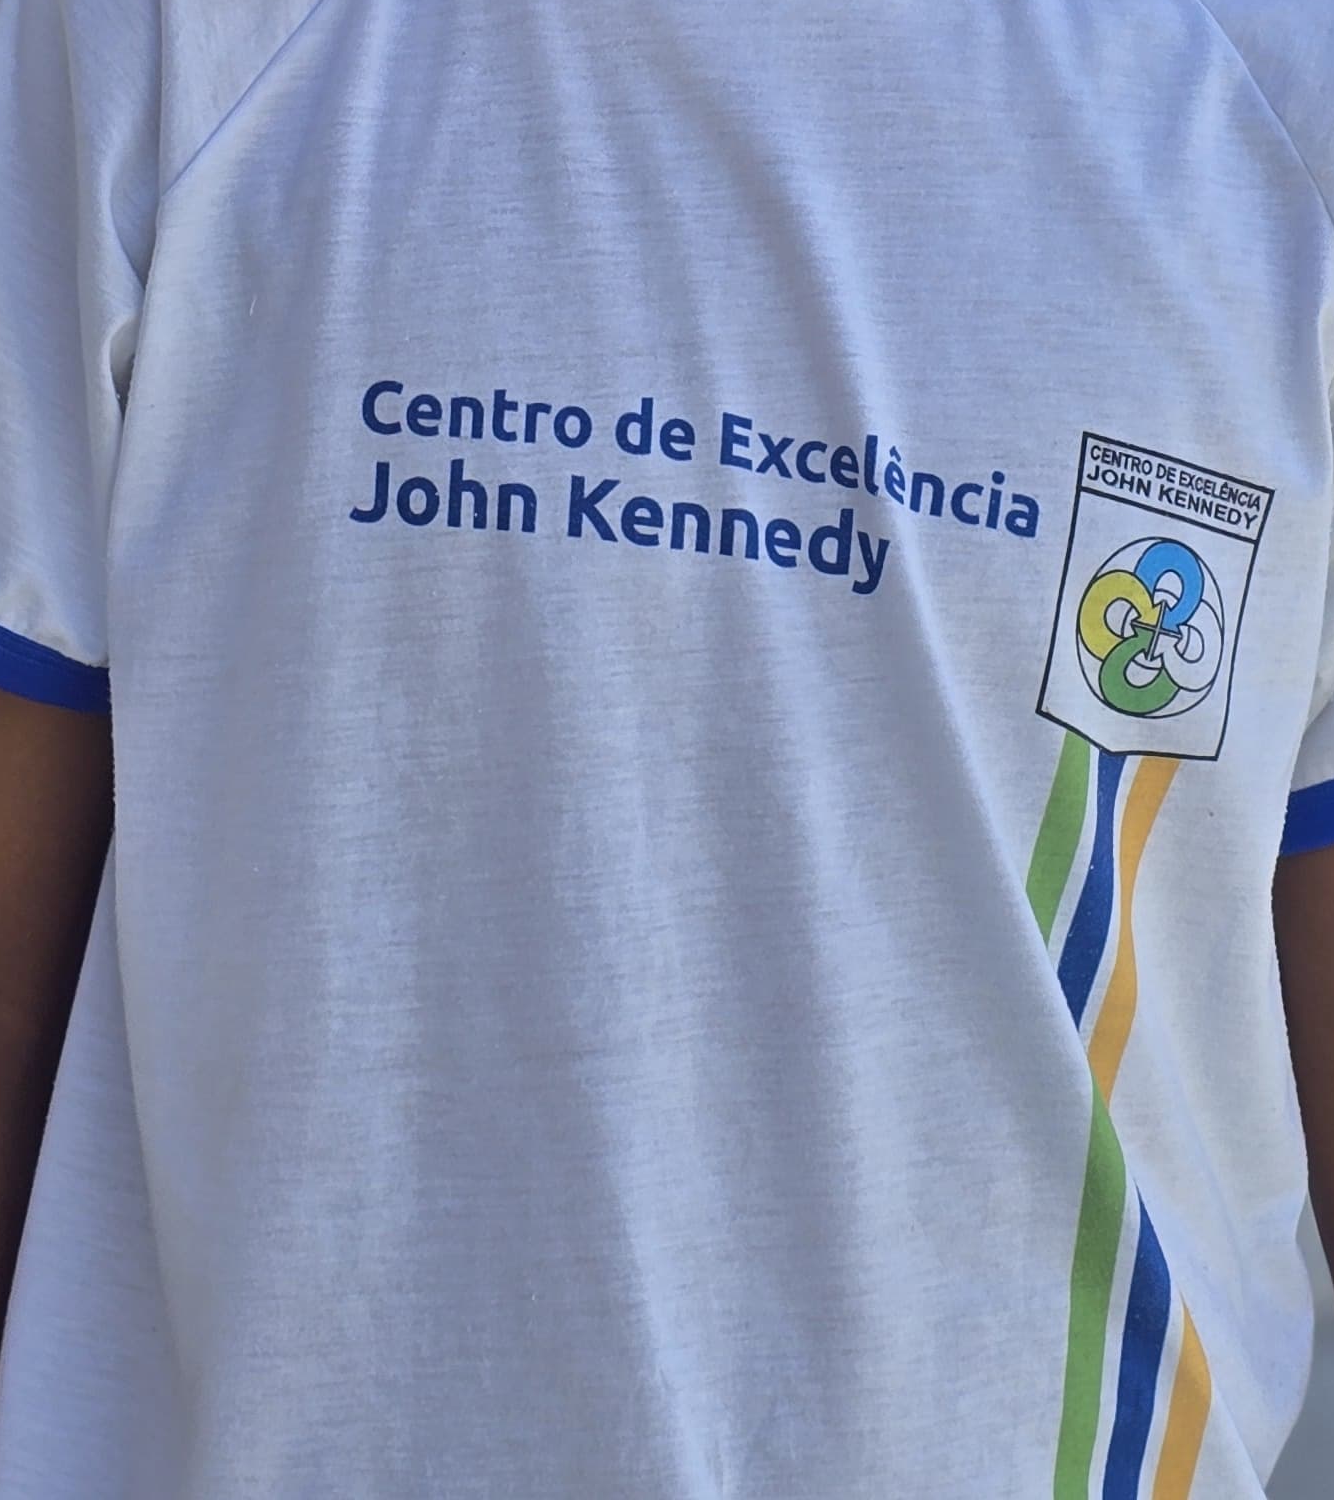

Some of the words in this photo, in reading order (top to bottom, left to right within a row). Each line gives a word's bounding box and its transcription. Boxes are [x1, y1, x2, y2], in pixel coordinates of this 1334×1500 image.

[361, 380, 593, 450] Centro
[615, 397, 697, 462] de
[718, 412, 1042, 539] Excelência
[1087, 465, 1152, 498] JOHN
[1158, 484, 1258, 530] KENNEDY
[1090, 445, 1152, 476] CENTRO
[1156, 463, 1176, 483] DE
[1179, 470, 1261, 511] EXCELÊNCIA
[349, 458, 538, 534] John
[567, 474, 890, 595] Kennedy
